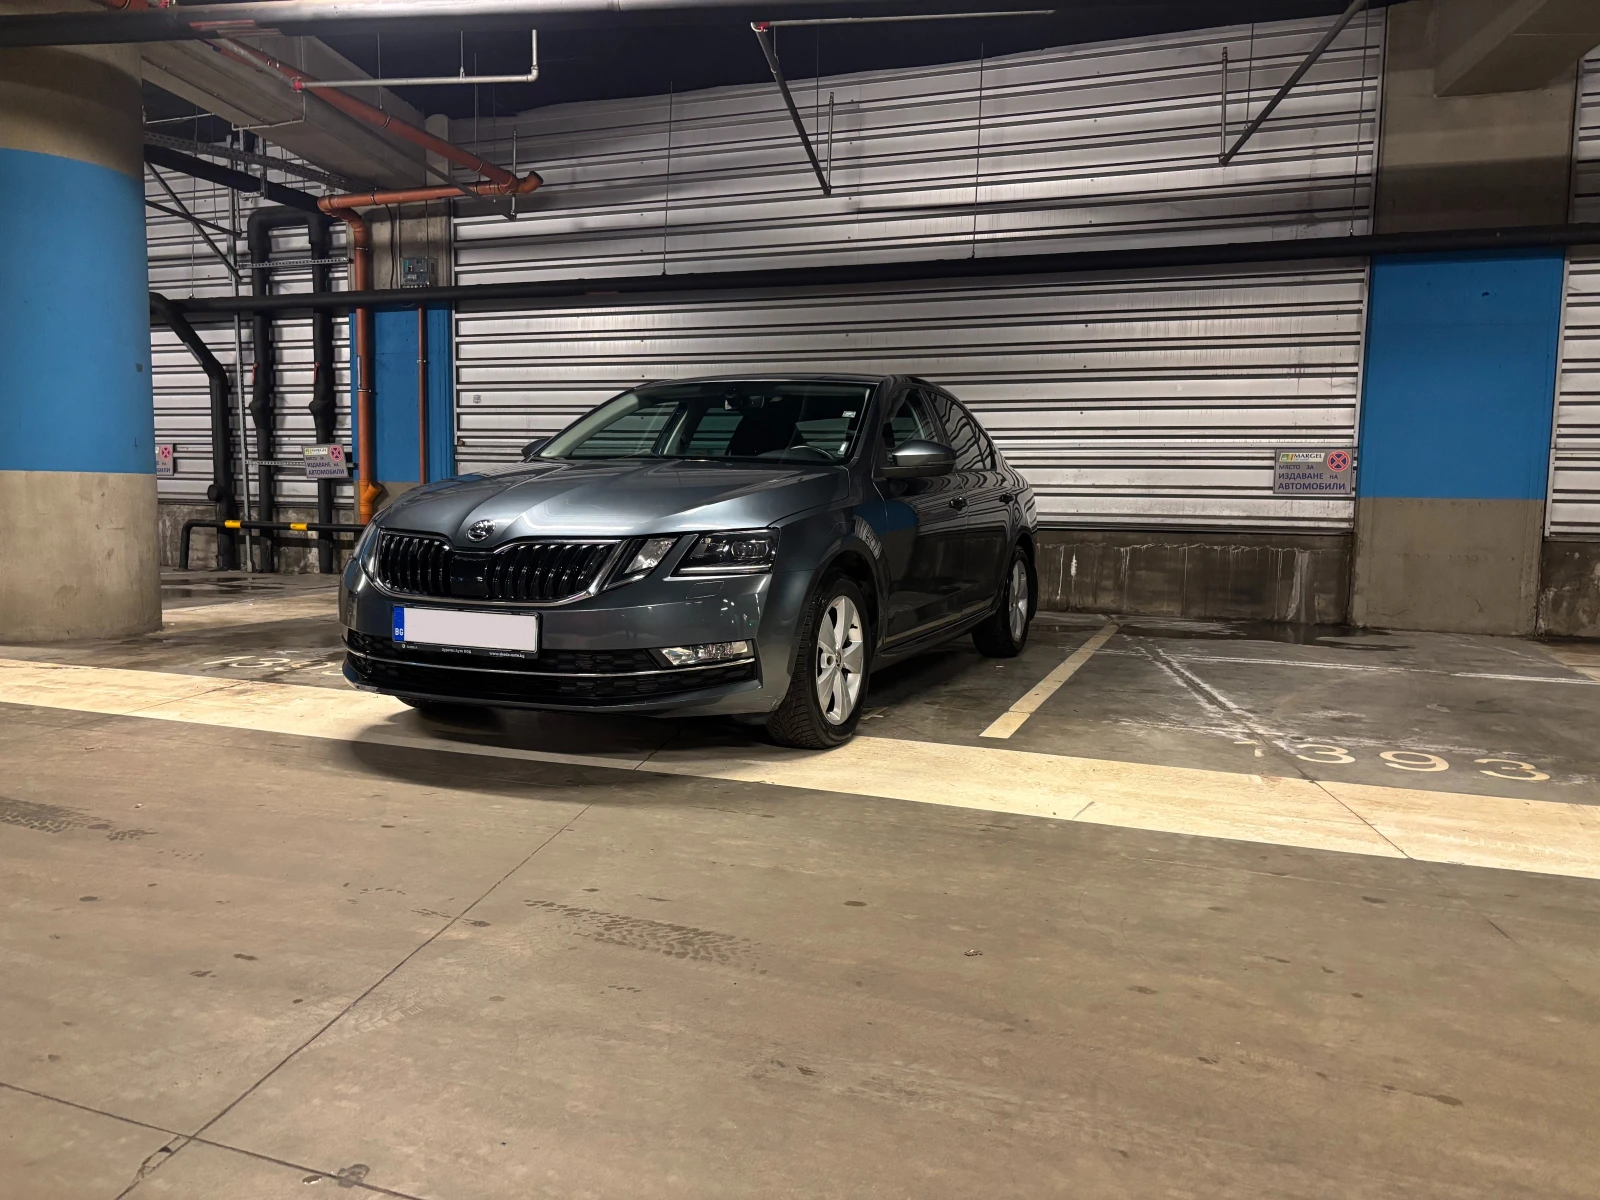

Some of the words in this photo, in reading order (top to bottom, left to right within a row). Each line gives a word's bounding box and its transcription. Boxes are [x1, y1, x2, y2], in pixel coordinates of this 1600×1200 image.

[1278, 472, 1324, 480] ИЗДАВАНЕ
[1277, 482, 1346, 490] АВТОМОБИЛИ
[394, 627, 404, 636] BG
